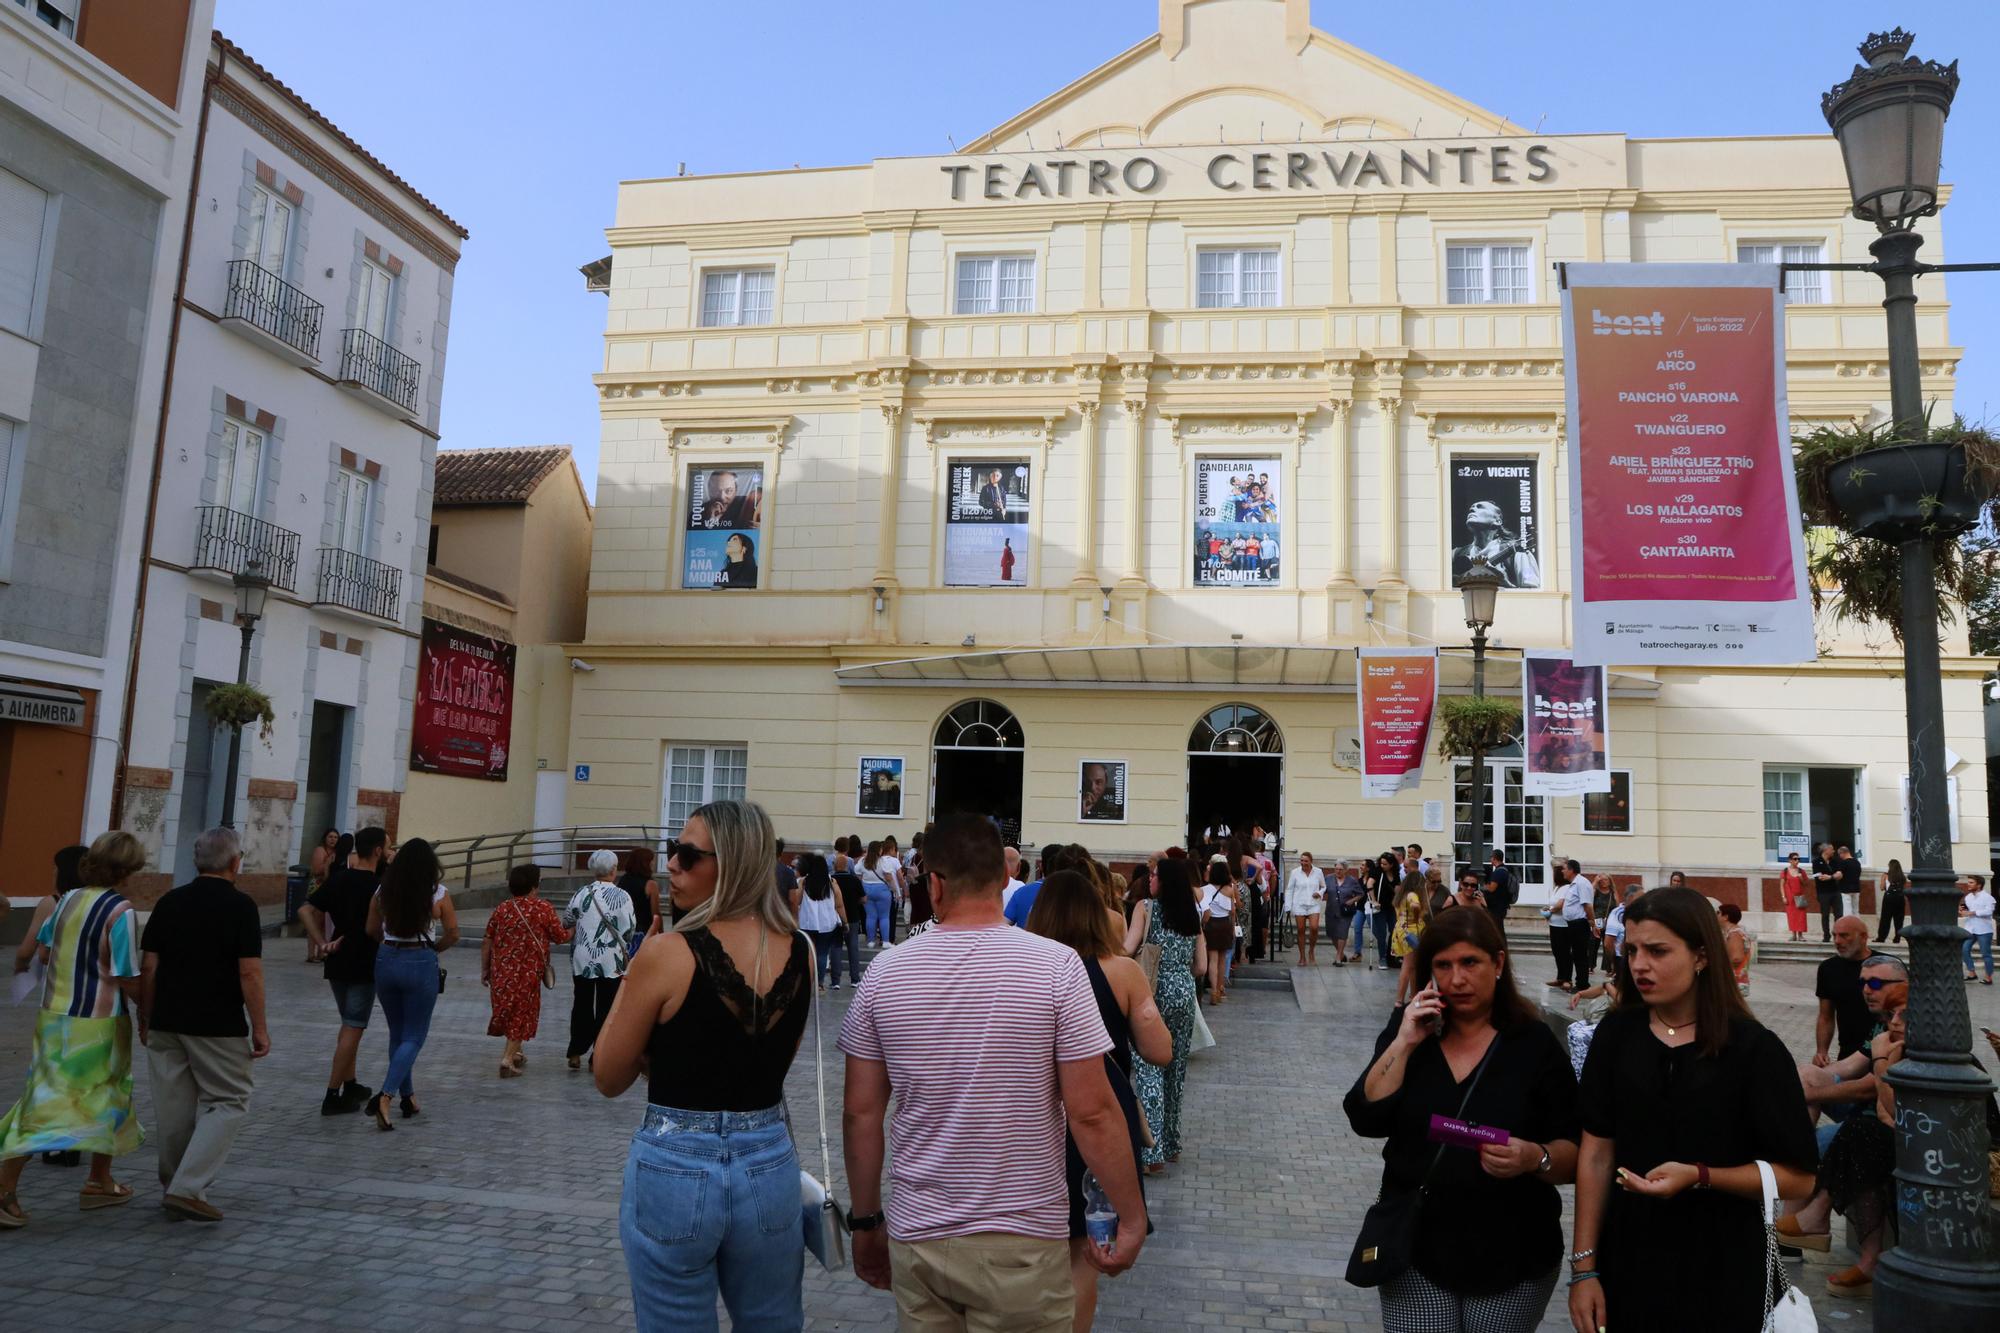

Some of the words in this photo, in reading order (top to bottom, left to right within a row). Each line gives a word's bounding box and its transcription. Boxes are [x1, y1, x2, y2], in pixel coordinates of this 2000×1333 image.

[941, 157, 1158, 200] TEATRO
[1206, 144, 1550, 190] CERVANTES
[1592, 309, 1665, 336] beat
[1696, 323, 1717, 333] julio
[1719, 323, 1744, 332] 2022
[1666, 350, 1684, 359] v15
[1655, 360, 1696, 371] ARCO
[1668, 382, 1686, 391] s16
[1618, 392, 1676, 404] PANCHO
[1679, 392, 1739, 404] VARONA
[1669, 414, 1688, 424] v22
[1634, 424, 1726, 436] TWANGUERO
[1671, 446, 1690, 456] s23
[1199, 463, 1254, 472] CANDELARIA
[1609, 456, 1648, 468] ARIEL
[1650, 454, 1722, 469] BRÍNGUEZ
[1724, 455, 1754, 470] TRÍO
[1487, 466, 1530, 478] VICENTE
[1627, 468, 1649, 476] FEAT.
[1651, 468, 1684, 476] KUMAR
[1686, 468, 1731, 476] SUBLEVAO
[1732, 468, 1739, 476] &
[953, 467, 962, 493] FARUK
[1647, 476, 1676, 484] JAVIER
[1199, 472, 1208, 505] PUERTO
[692, 474, 705, 527] TOQUINHO
[1519, 479, 1531, 513] AMIGO
[1674, 494, 1694, 504] v29
[951, 494, 960, 521] OMAR
[1626, 504, 1654, 516] LOS
[1657, 504, 1743, 518] MALAGATOS
[1659, 516, 1693, 525] Folclore
[1694, 517, 1712, 525] vivo
[1677, 536, 1697, 545] s30
[1639, 546, 1735, 560] ÇANTAMARTA
[690, 559, 712, 570] ANA
[689, 571, 729, 583] MOURA
[1200, 569, 1213, 581] EL
[1216, 567, 1261, 581] COMITÉ
[1639, 641, 1719, 651] teatroechegaray.es
[9, 701, 76, 723] ALHAMBRA
[1534, 694, 1597, 720] beat
[432, 707, 447, 727] DE
[863, 759, 893, 769] MOURA
[862, 768, 873, 785] ANA
[1114, 765, 1124, 805] TOQUINHO
[1443, 1121, 1468, 1133] Teatro
[1470, 1127, 1496, 1139] Regala
